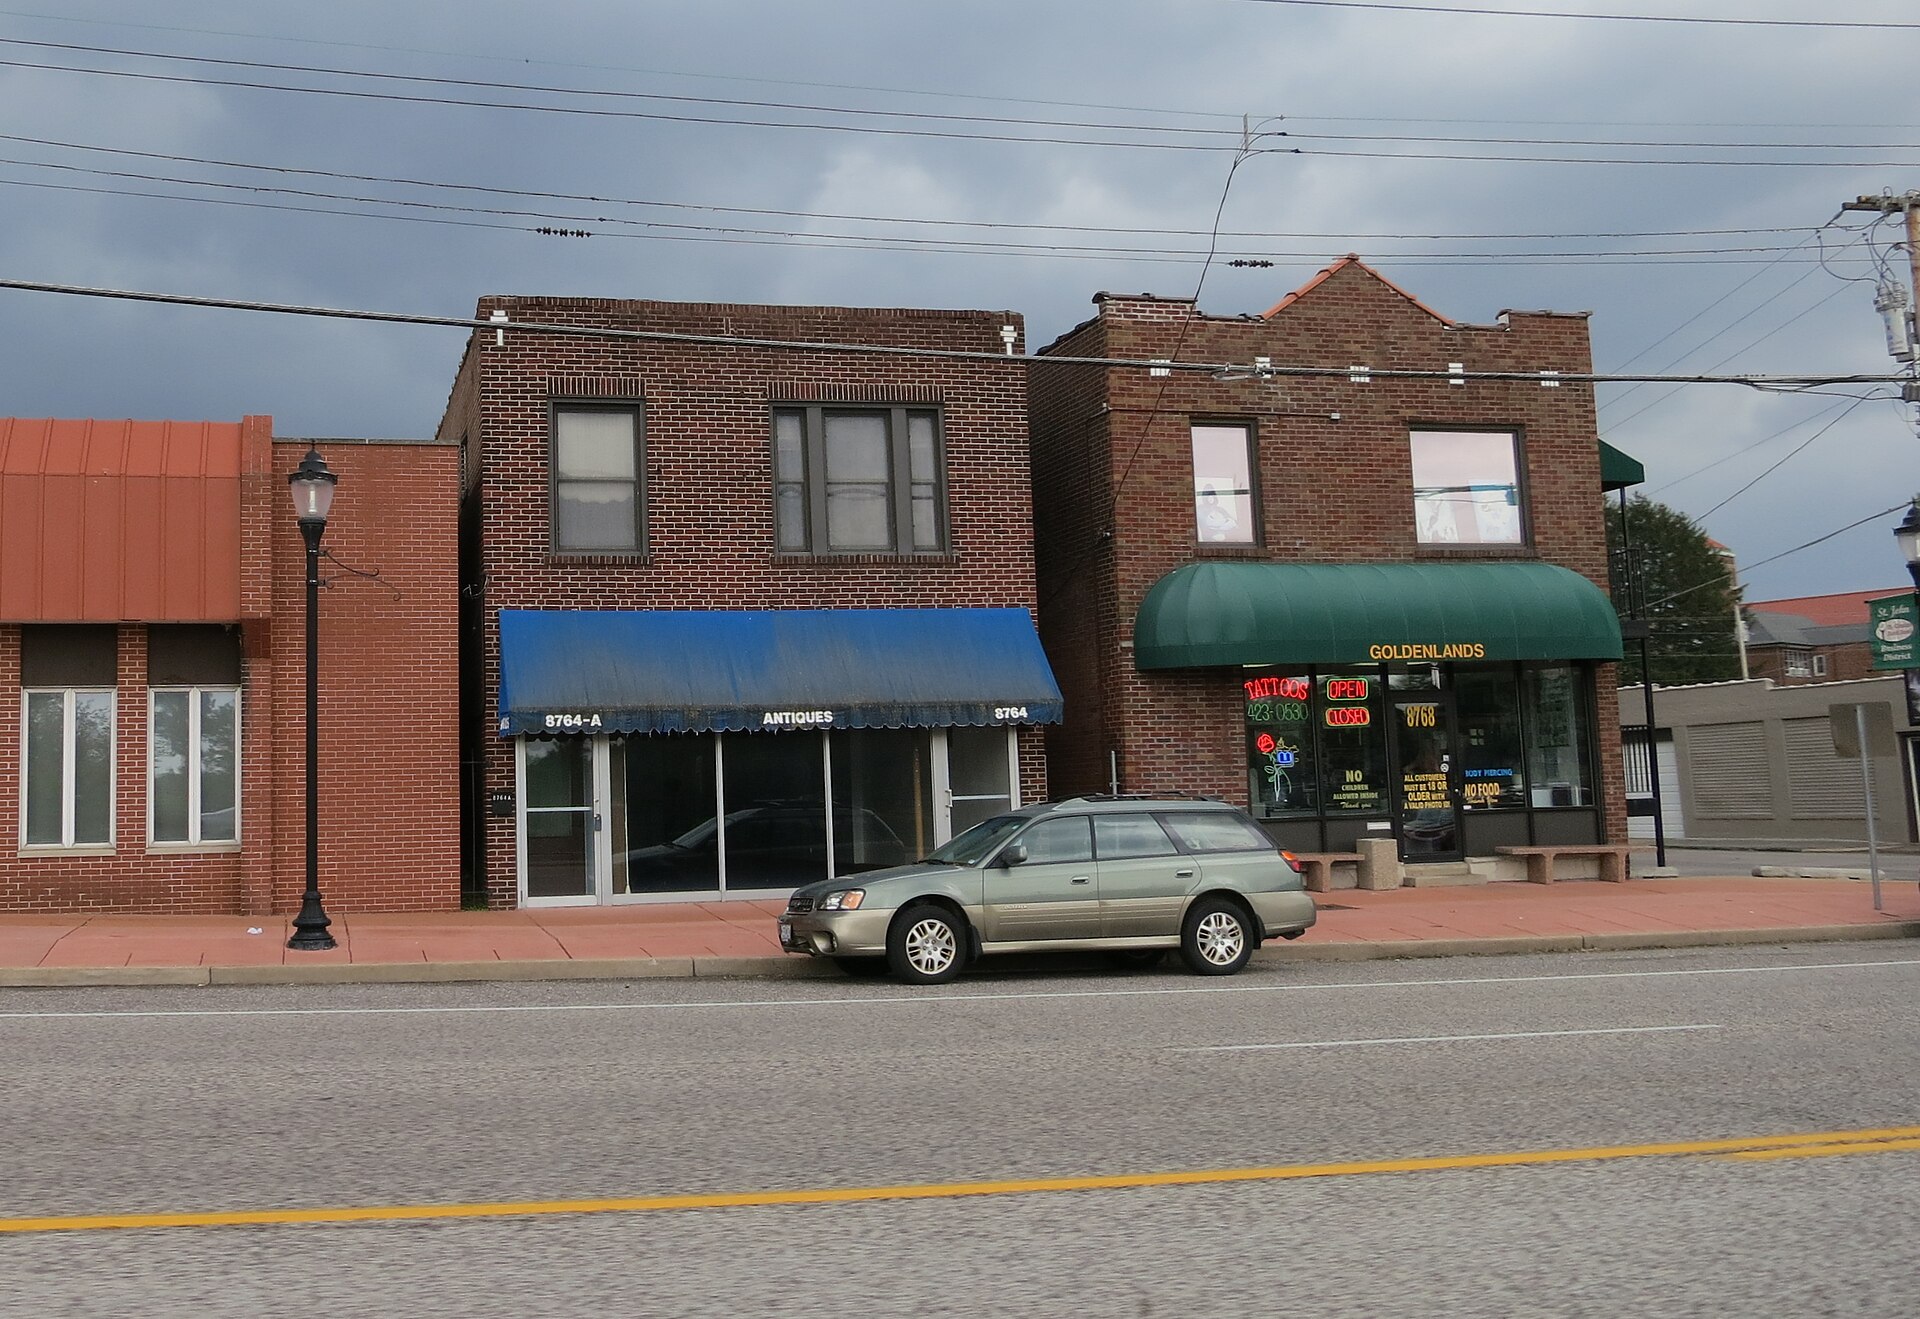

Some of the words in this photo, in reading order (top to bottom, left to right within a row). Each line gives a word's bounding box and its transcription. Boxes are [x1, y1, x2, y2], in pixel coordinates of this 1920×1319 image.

[1369, 643, 1485, 659] GOLDENLANDS
[1883, 653, 1911, 661] District
[1244, 677, 1309, 700] TATTOOS
[1329, 680, 1366, 699] OPEN
[763, 711, 834, 724] ANTIQUES
[994, 707, 1028, 719] 8764
[1247, 703, 1309, 721] 423-0530
[1328, 709, 1368, 724] CLOSED
[1406, 706, 1436, 727] 8768
[545, 714, 602, 727] 8764-A
[1345, 770, 1363, 782] NO
[1404, 774, 1414, 782] ALL
[1414, 773, 1447, 781] CUSTOMERS
[1483, 768, 1513, 776] PIERCING
[1404, 784, 1419, 792] MUST
[1419, 783, 1427, 791] BE
[1428, 781, 1436, 791] 18
[1437, 781, 1448, 791] OR
[1464, 784, 1477, 797] NO
[1478, 782, 1500, 796] FOOD
[1408, 792, 1431, 801] OLDER
[1403, 802, 1409, 810] A
[1408, 801, 1425, 810] VALID
[1424, 801, 1443, 809] PHOTO
